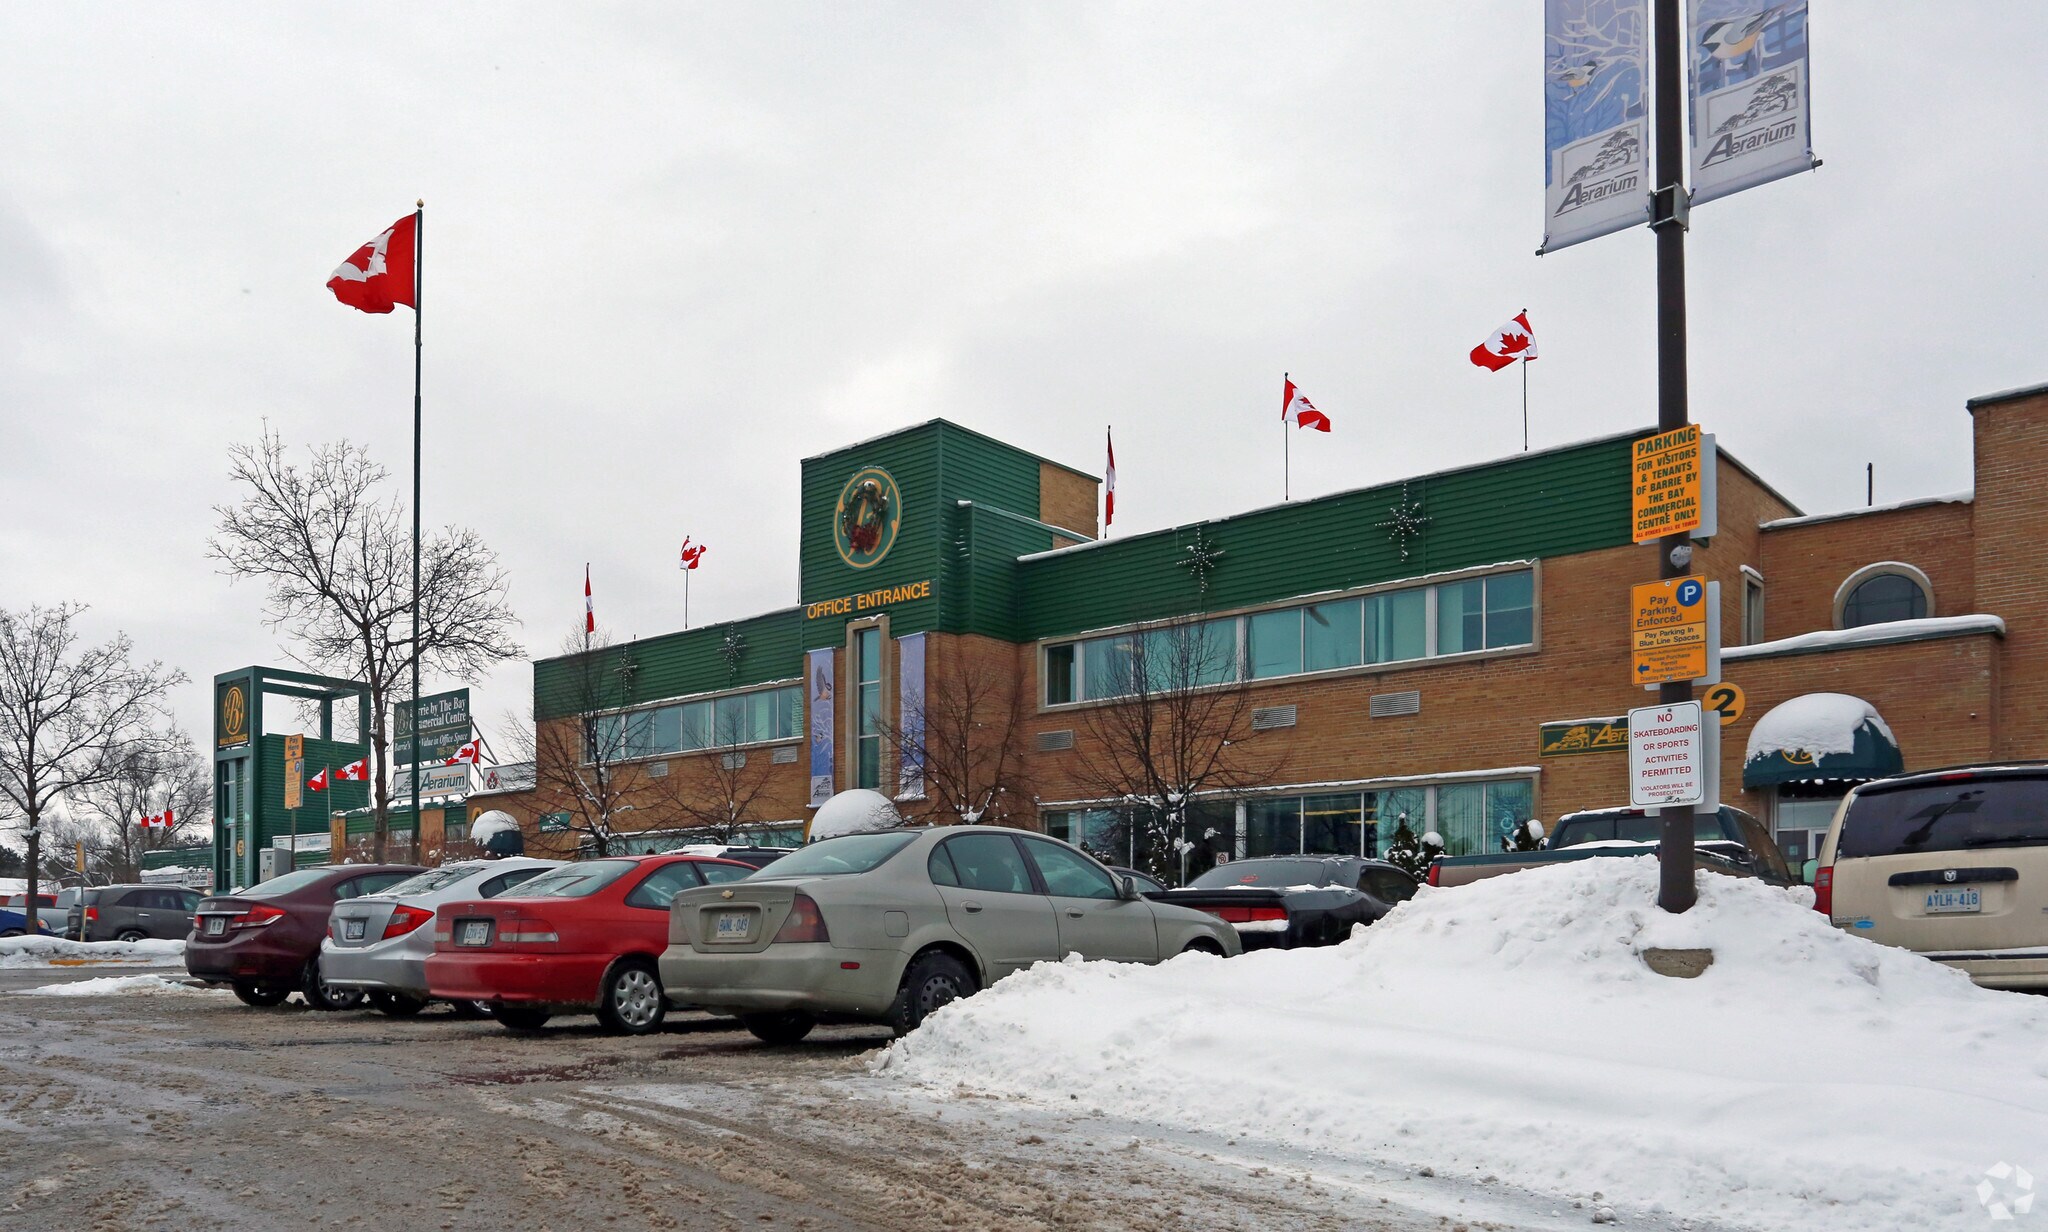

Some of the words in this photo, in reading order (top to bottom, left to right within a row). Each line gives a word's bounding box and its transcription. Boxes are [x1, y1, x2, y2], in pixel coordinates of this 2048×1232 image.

[1701, 123, 1796, 166] Aerarium
[1555, 176, 1637, 214] Aerarium
[1638, 428, 1696, 456] PARKING
[1637, 461, 1652, 472] FOR
[1657, 448, 1696, 466] VISITORS
[1641, 474, 1647, 482] &
[1652, 462, 1692, 480] TENANTS
[1636, 485, 1646, 495] OF
[1650, 476, 1682, 492] BARRIE
[1686, 472, 1697, 482] BY
[1648, 493, 1664, 504] THE
[1668, 487, 1685, 499] BAY
[1638, 497, 1696, 519] COMMERCIAL
[1638, 514, 1670, 531] CENTRE
[1674, 508, 1696, 521] ONLY
[807, 598, 851, 619] OFFICE
[857, 582, 930, 610] ENTRANCE
[1650, 596, 1669, 605] Pay
[1684, 585, 1696, 601] P
[1640, 605, 1677, 617] Parking
[1637, 613, 1682, 628] Enforced
[1660, 628, 1685, 636] Parking
[1674, 634, 1700, 643] Spaces
[410, 703, 429, 718] Brrie
[431, 702, 438, 717] by
[440, 699, 451, 712] The
[453, 697, 466, 711] Bay
[1711, 688, 1736, 717] 2
[410, 713, 444, 731] Cmmercial
[446, 712, 466, 724] Centre
[1658, 713, 1672, 723] NO
[422, 737, 433, 746] Value
[434, 736, 438, 745] in
[440, 733, 453, 746] Office
[454, 732, 468, 744] Space
[1591, 724, 1629, 745] Aera
[1634, 724, 1698, 738] SKATEBOARDING
[1657, 739, 1689, 749] SPORTS
[1645, 753, 1688, 764] ACTIVITIES
[1642, 766, 1691, 778] PERMITTED
[419, 772, 464, 791] Aerarium
[1641, 784, 1670, 792] VIOLATORS
[1648, 789, 1685, 797] PROSECUTED.
